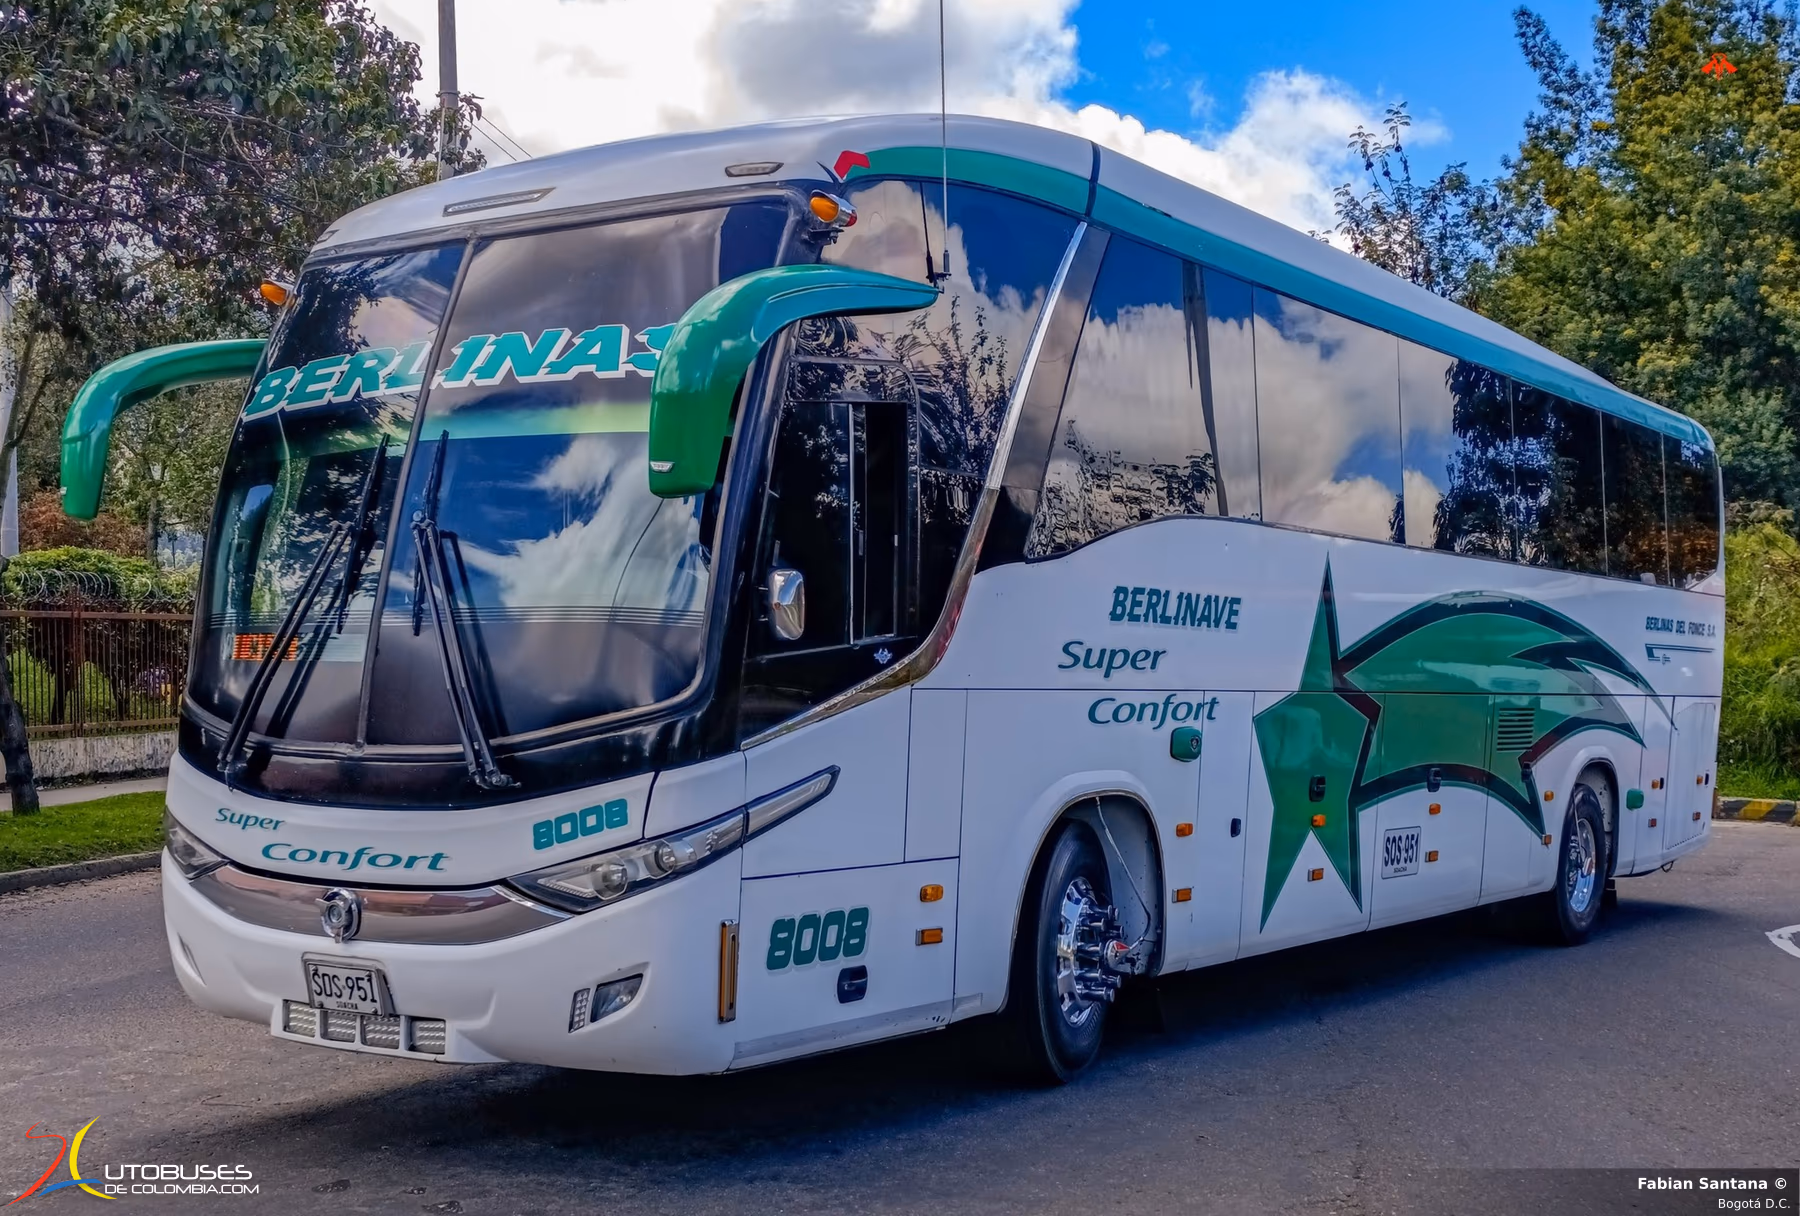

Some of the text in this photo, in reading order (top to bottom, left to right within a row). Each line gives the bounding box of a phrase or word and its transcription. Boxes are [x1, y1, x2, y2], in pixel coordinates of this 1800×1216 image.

[1108, 586, 1242, 630] BERLINAVE
[1645, 616, 1674, 632] BERLINAS
[1675, 620, 1686, 634] DEL
[1688, 622, 1706, 636] FONCE
[1057, 640, 1167, 678] Super
[1087, 693, 1220, 730] Confort
[215, 808, 286, 830] Super
[532, 798, 629, 851] 8008
[261, 843, 450, 871] Confort
[766, 906, 870, 971] 8008
